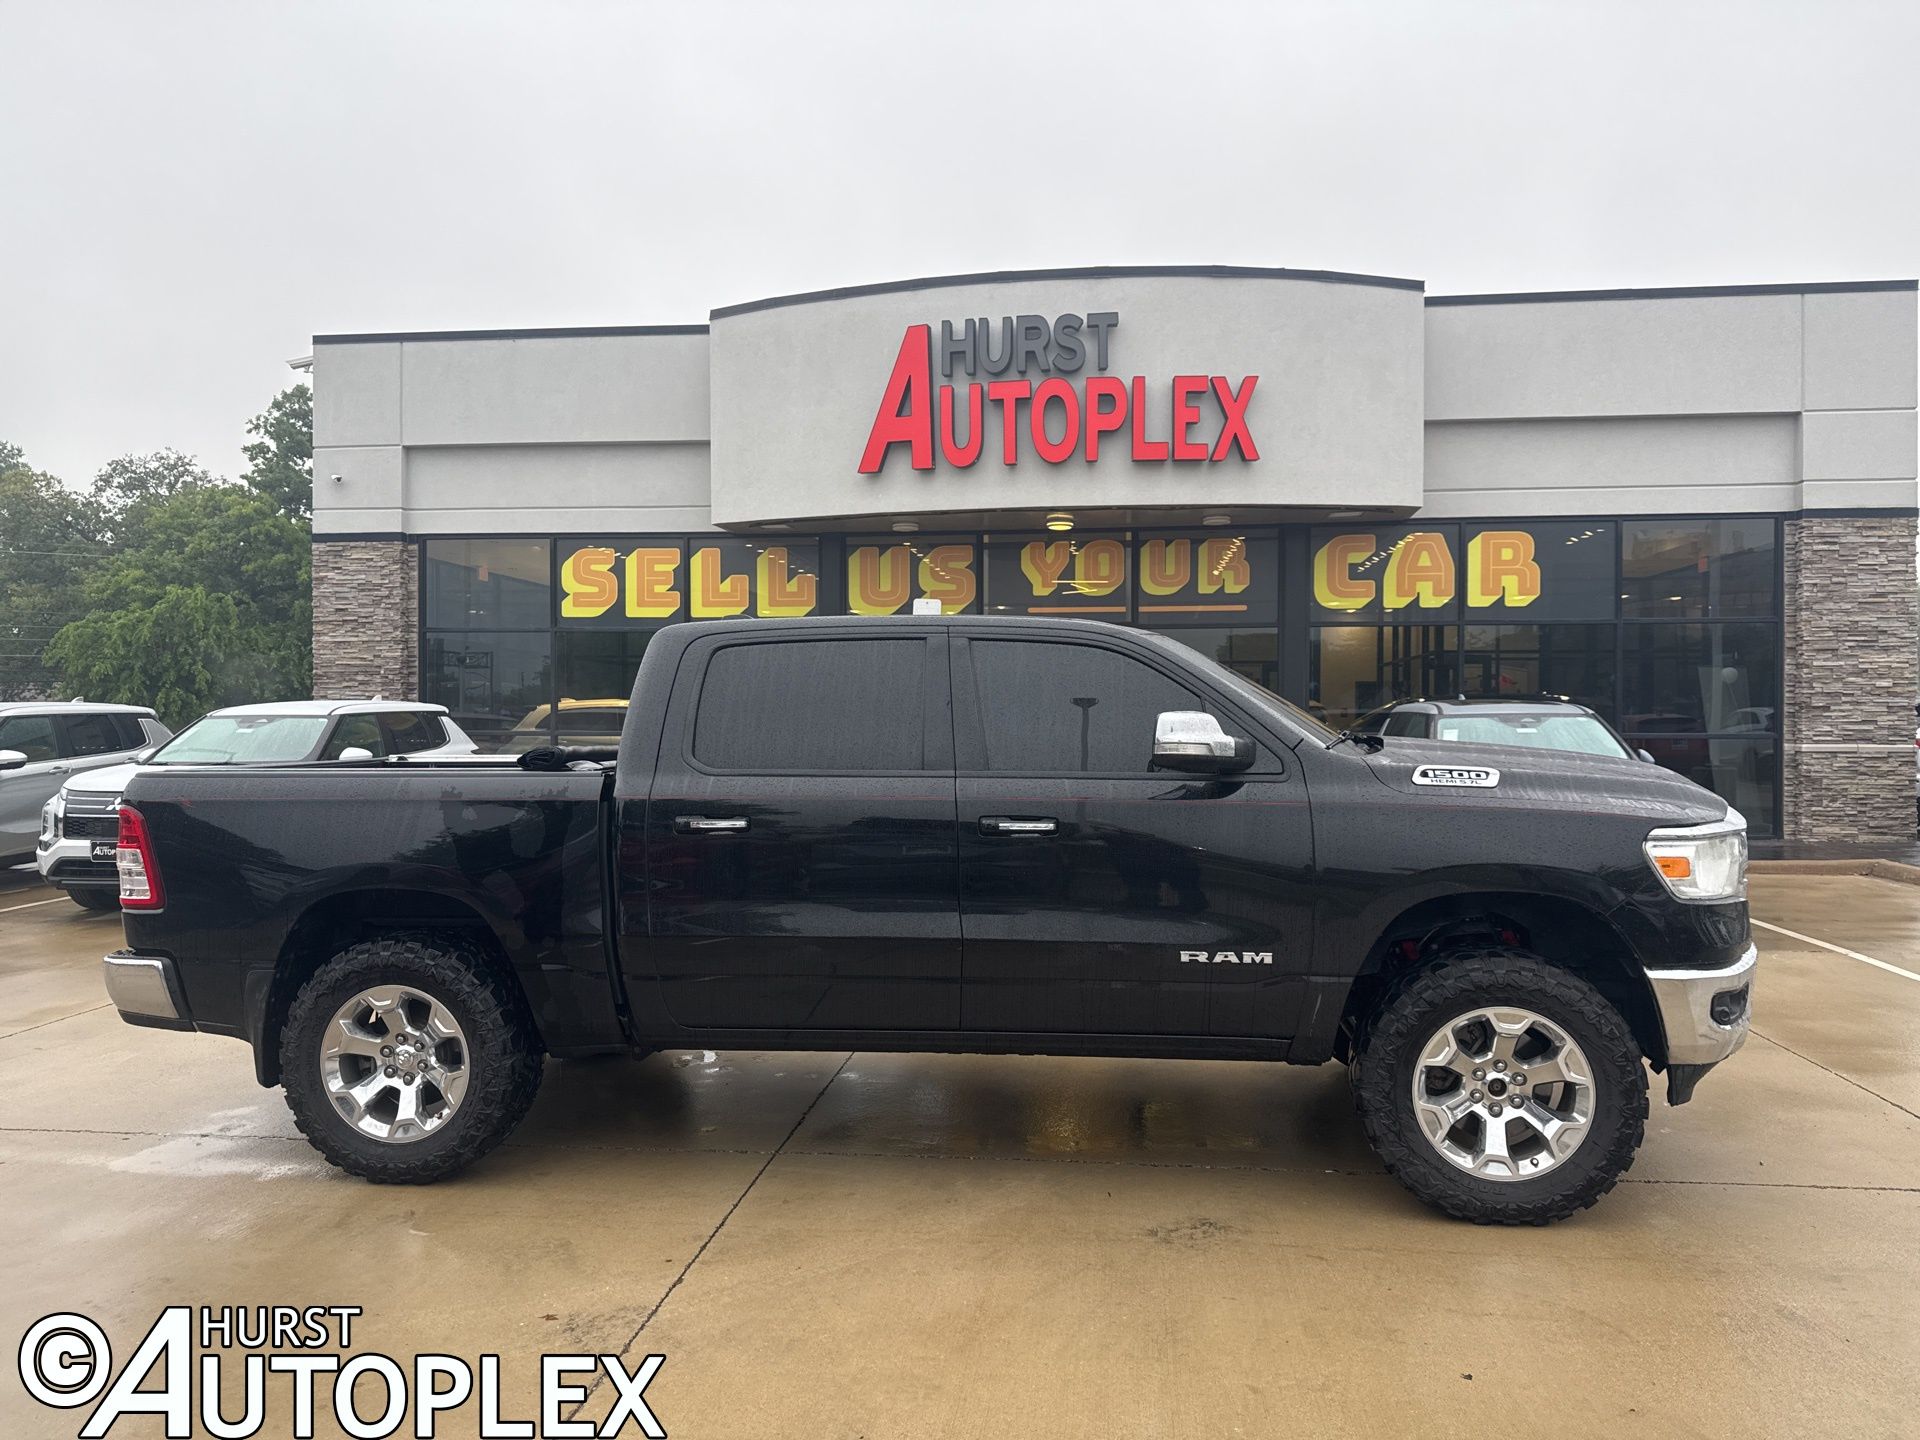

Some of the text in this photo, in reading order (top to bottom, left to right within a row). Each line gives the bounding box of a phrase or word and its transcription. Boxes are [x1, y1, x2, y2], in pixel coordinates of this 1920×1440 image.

[941, 312, 1119, 377] HURST
[857, 324, 1260, 474] AUTOPLEX
[561, 531, 1541, 618] SELL US YOUR CAR
[1424, 769, 1487, 780] 1500
[1180, 951, 1273, 964] RAM
